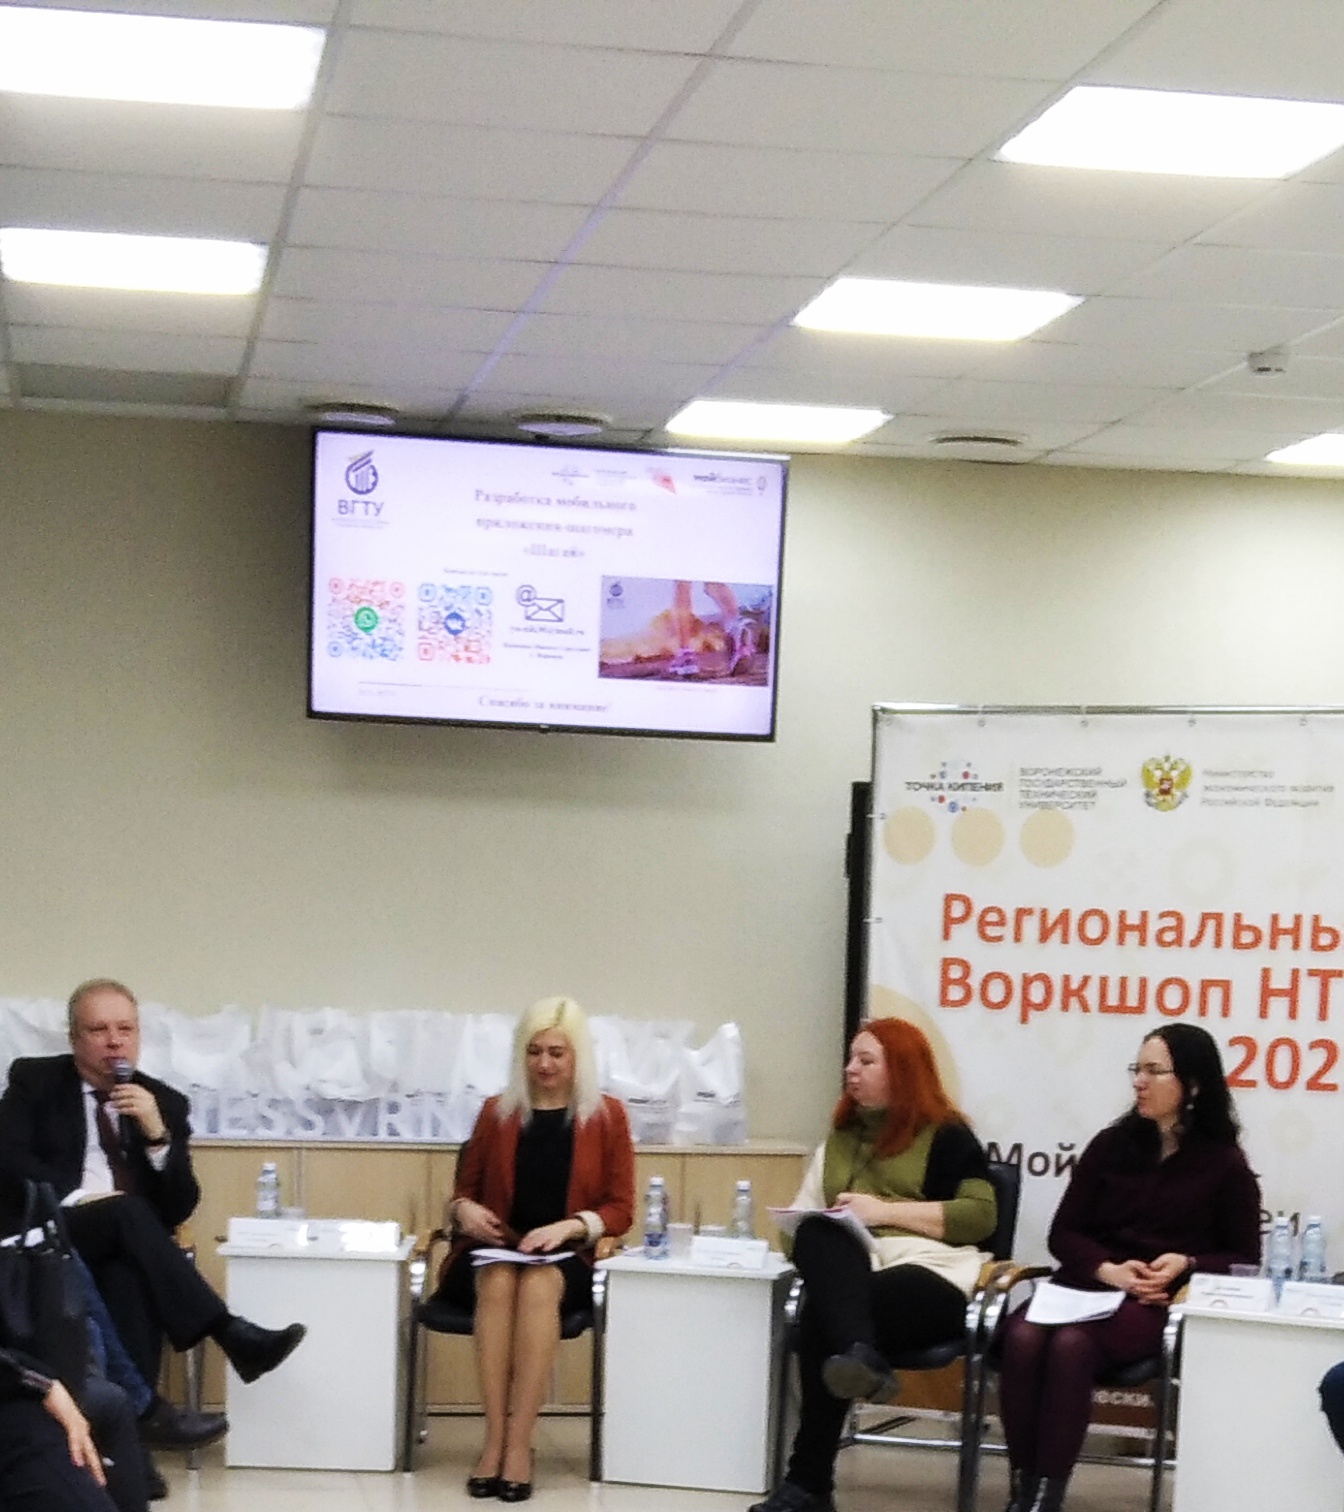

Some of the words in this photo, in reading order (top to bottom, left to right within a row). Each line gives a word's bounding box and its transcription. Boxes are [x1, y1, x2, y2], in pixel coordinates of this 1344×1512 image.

[338, 498, 385, 517] ВГТУ
[905, 781, 945, 793] ТОЧКА
[947, 781, 1005, 793] КИПЕНИЯ
[938, 956, 1233, 1025] Воркшоп
[986, 1140, 1077, 1179] Мой
